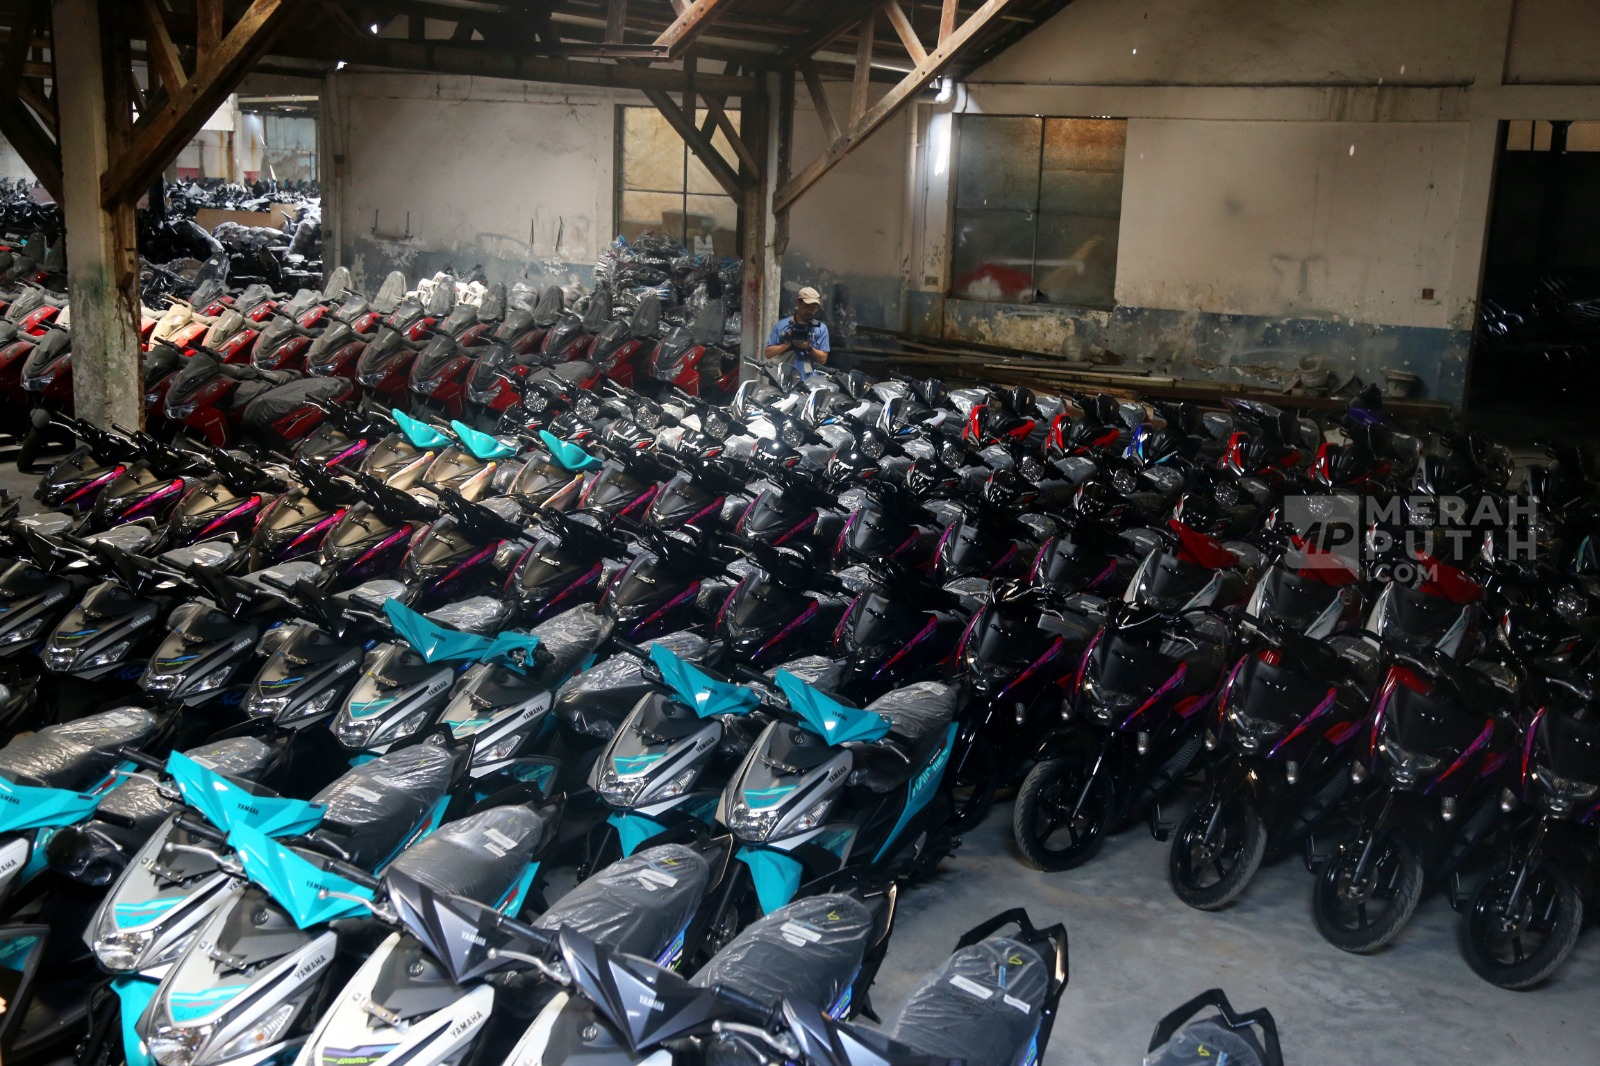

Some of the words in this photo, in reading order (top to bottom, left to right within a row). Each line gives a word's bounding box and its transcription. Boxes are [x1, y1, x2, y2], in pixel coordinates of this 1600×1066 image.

[336, 659, 357, 675] YAMAHA
[427, 681, 448, 697] YAMAHA
[523, 704, 545, 721] YAMAHA
[695, 736, 716, 753] YAMAHA
[828, 765, 848, 784] YAMAHA
[237, 803, 259, 816] YAMAHA
[460, 930, 487, 947] YAMAHA
[294, 954, 327, 980] YAMAHA
[638, 994, 665, 1012] YAMAHA
[451, 1010, 484, 1039] YAMAHA
